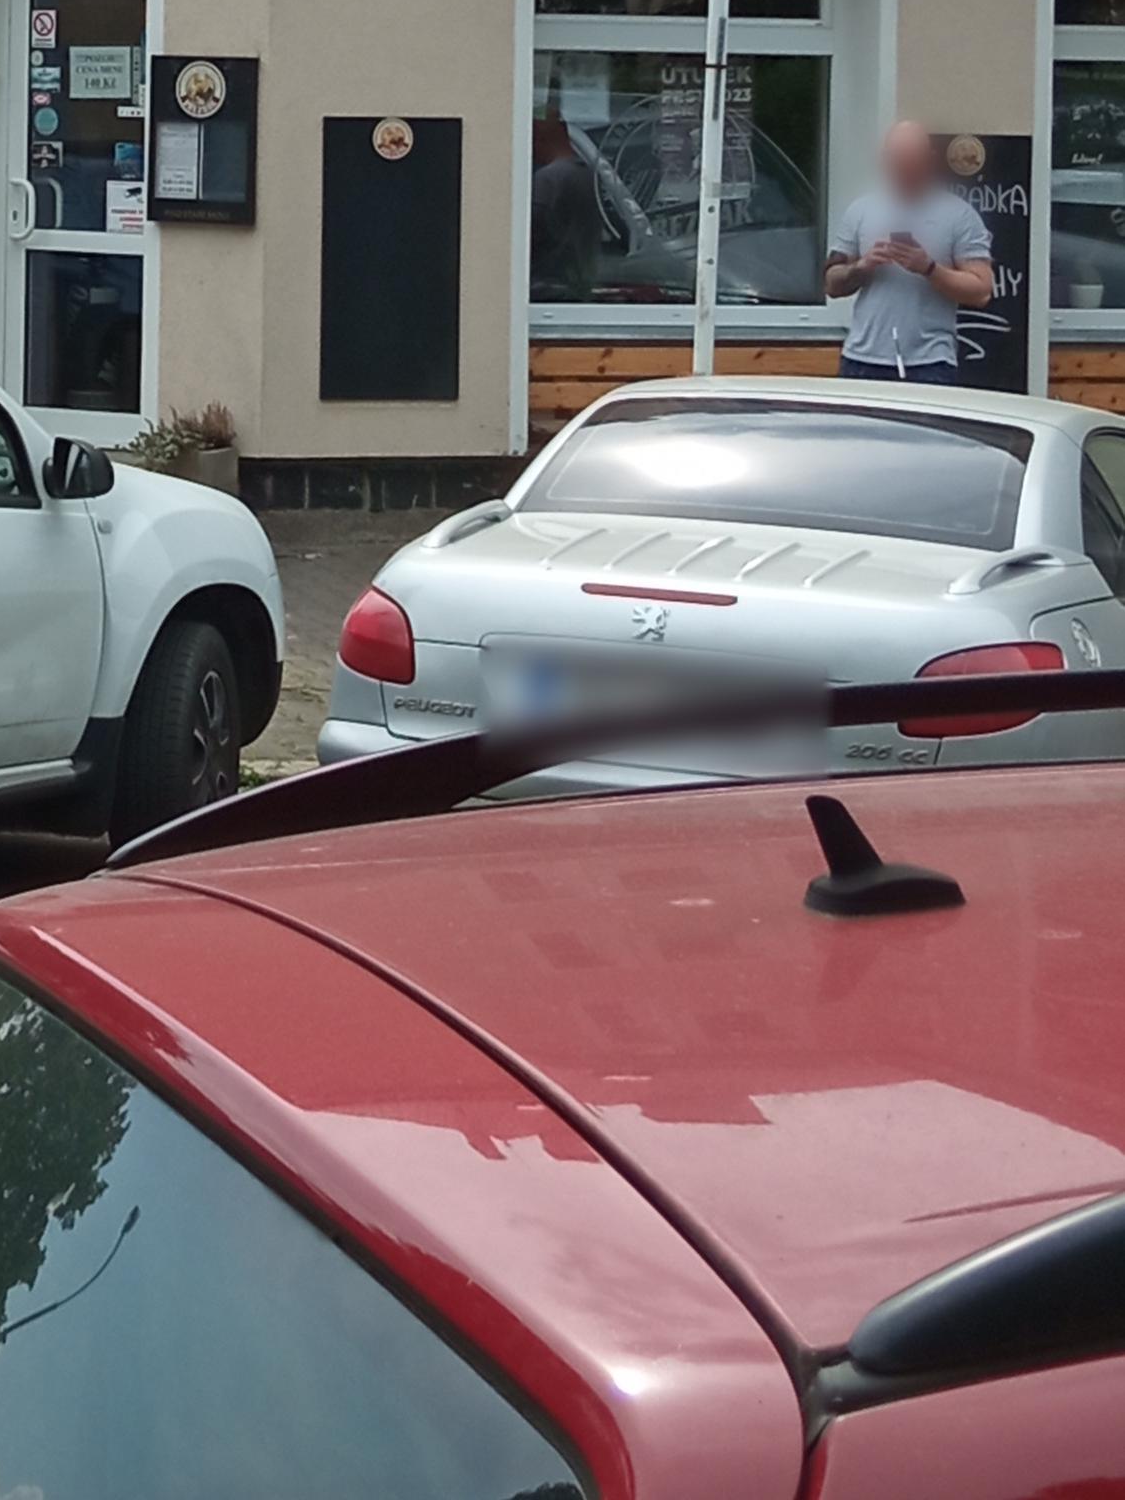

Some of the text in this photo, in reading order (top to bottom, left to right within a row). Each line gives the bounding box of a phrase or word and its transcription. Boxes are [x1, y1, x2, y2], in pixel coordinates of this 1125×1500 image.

[661, 63, 753, 85] ÚTUEK
[394, 697, 477, 719] PEUGEOT
[845, 743, 893, 761] 206
